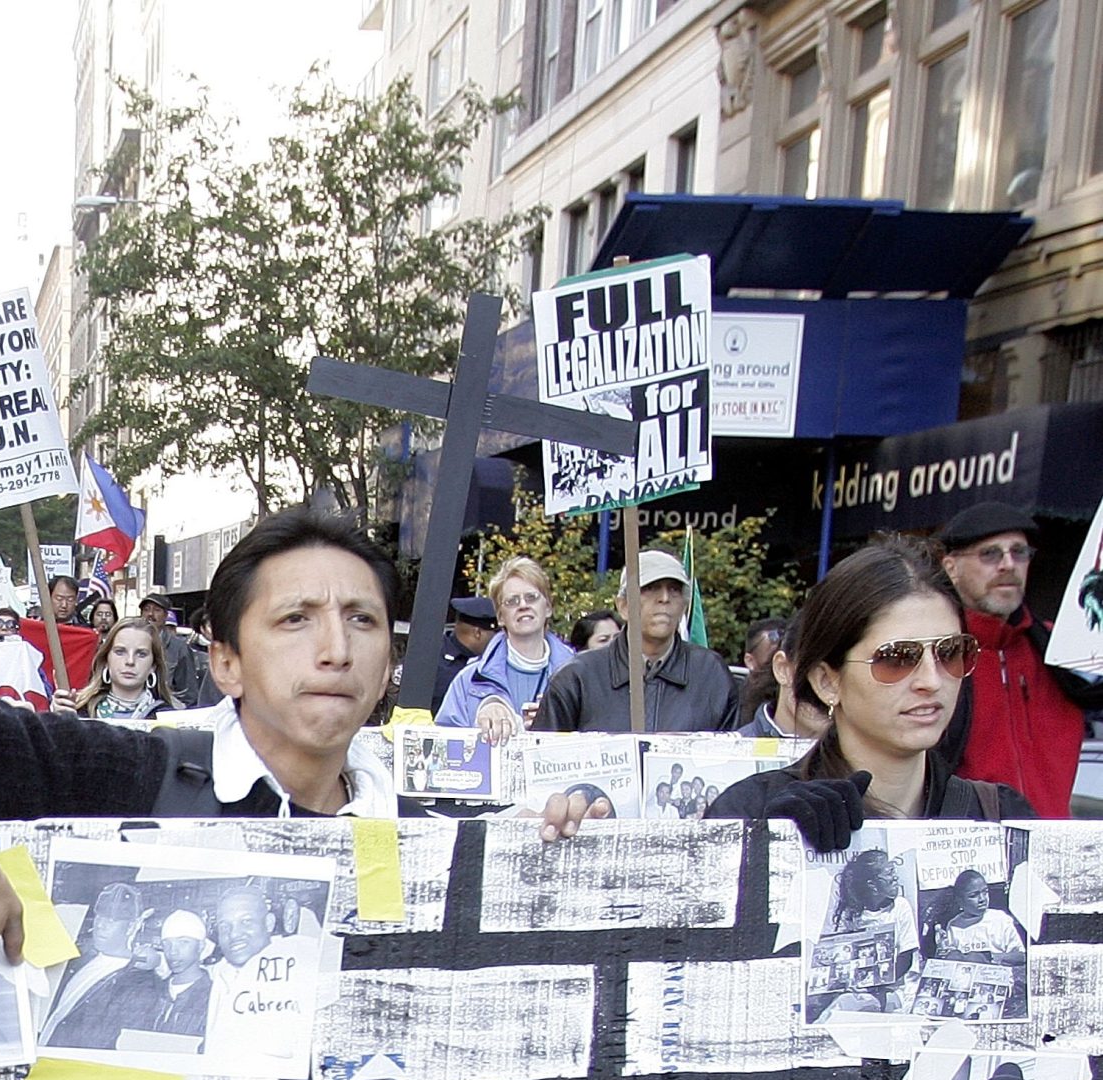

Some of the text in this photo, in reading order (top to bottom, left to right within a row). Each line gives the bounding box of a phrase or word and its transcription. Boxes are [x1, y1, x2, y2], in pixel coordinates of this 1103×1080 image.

[555, 270, 693, 343] FULL
[545, 312, 707, 398] LEGALIZATION
[736, 362, 791, 377] around
[644, 379, 698, 417] for
[637, 407, 709, 483] ALL
[811, 430, 1020, 513] kdding around
[601, 751, 629, 767] Rust
[610, 777, 632, 791] RIP
[950, 849, 977, 865] STOP
[257, 956, 296, 982] RIP
[233, 991, 301, 1014] Cabrera
